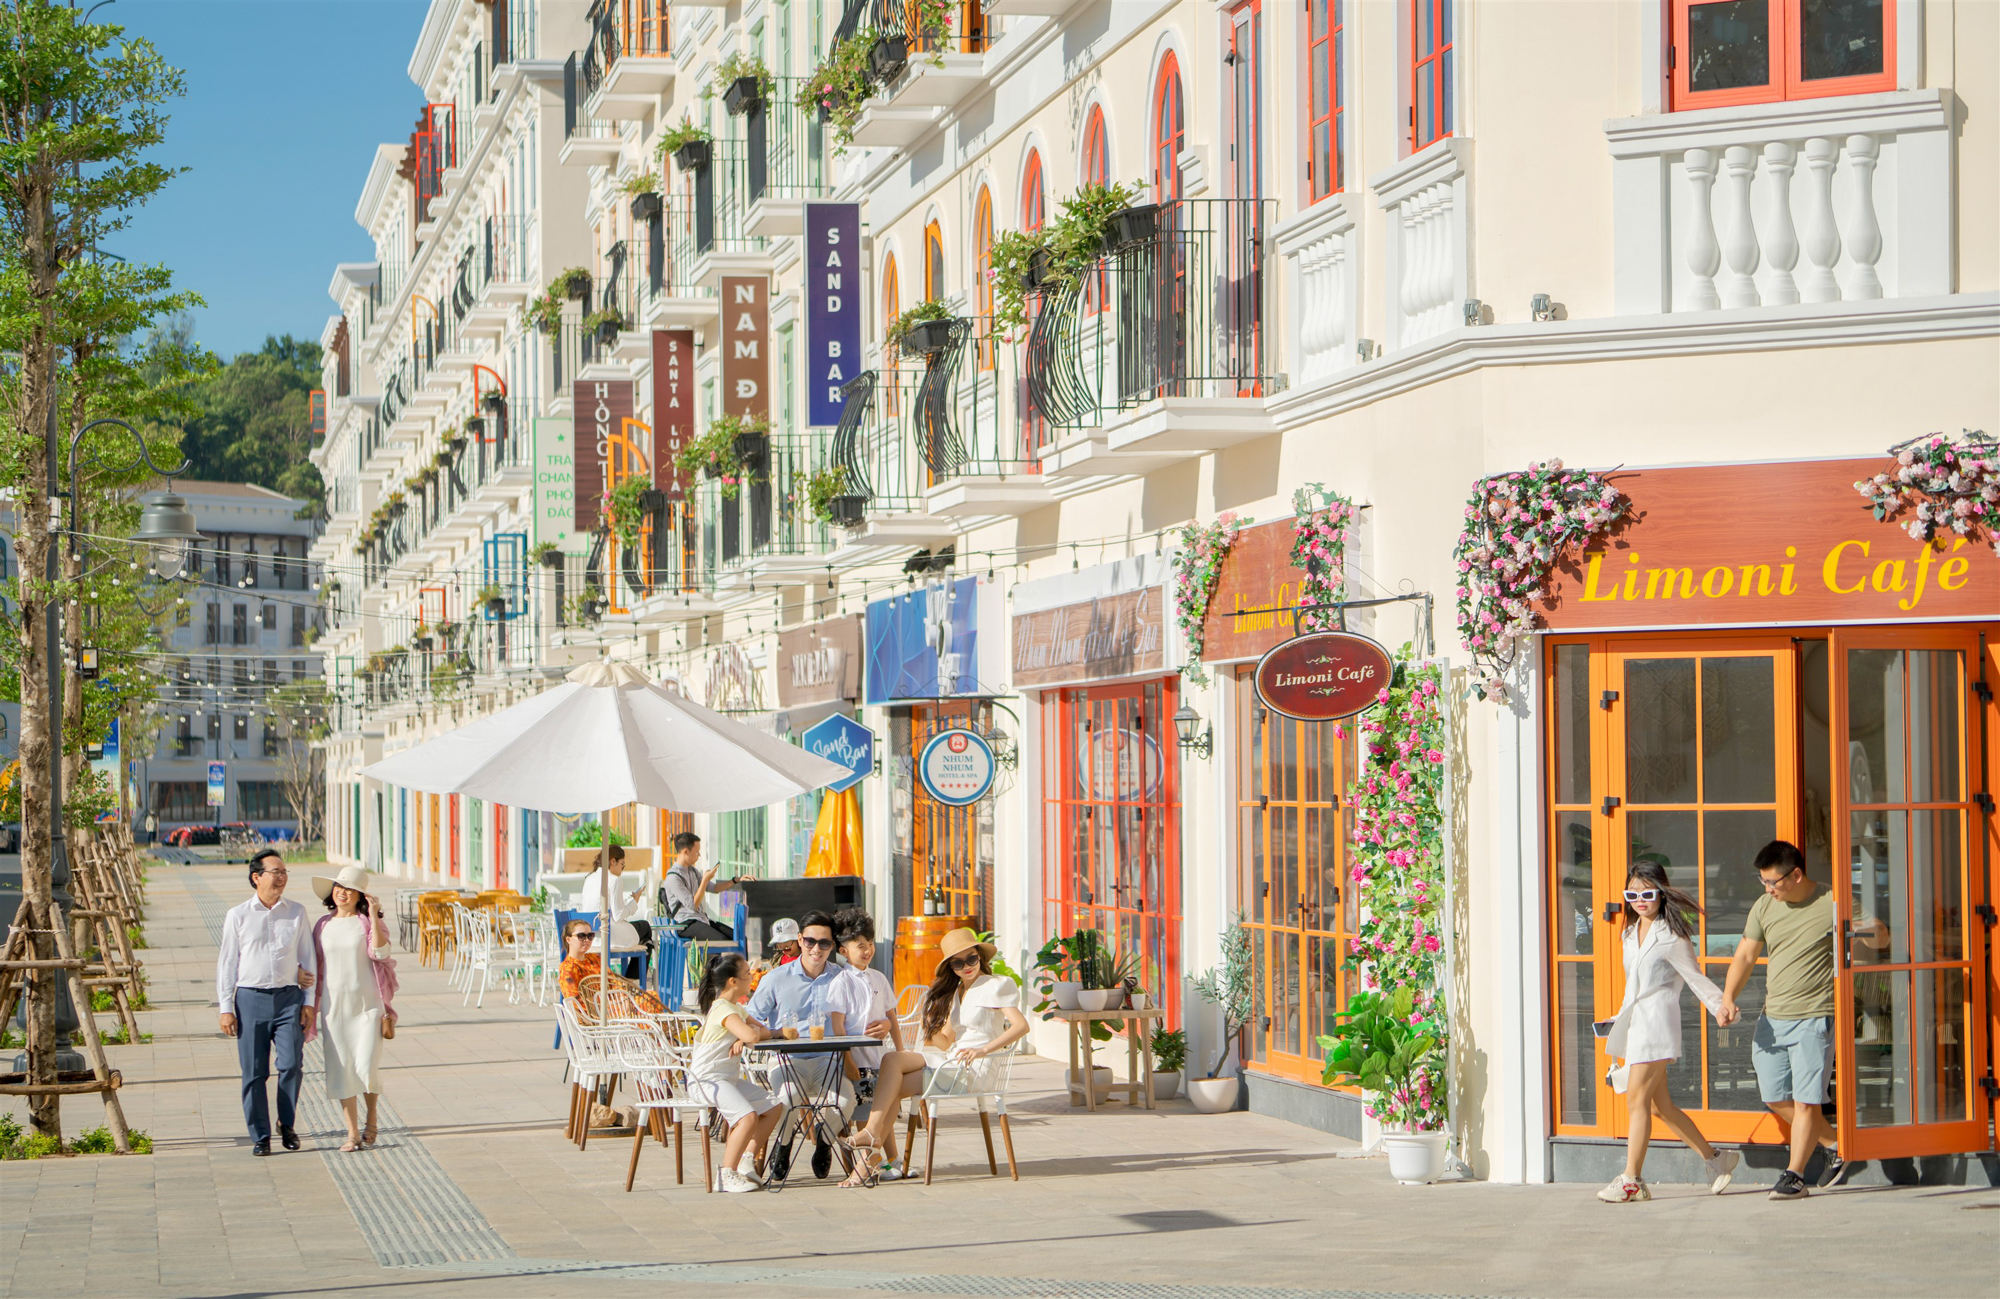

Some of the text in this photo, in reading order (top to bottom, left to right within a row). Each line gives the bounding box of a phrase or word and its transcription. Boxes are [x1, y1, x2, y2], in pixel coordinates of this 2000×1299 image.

[734, 285, 759, 359] NAM
[826, 228, 843, 403] SAND BAR
[668, 340, 680, 408] SANTA
[538, 472, 573, 484] CHAN
[1578, 536, 1969, 611] Limoni Café
[1234, 588, 1274, 633] Limoni
[1132, 590, 1158, 671] Spa
[1275, 665, 1375, 687] Limoni Café
[812, 726, 848, 759] Sand
[839, 743, 869, 769] Bar
[943, 755, 974, 763] NHUM
[943, 764, 974, 772] NHUM
